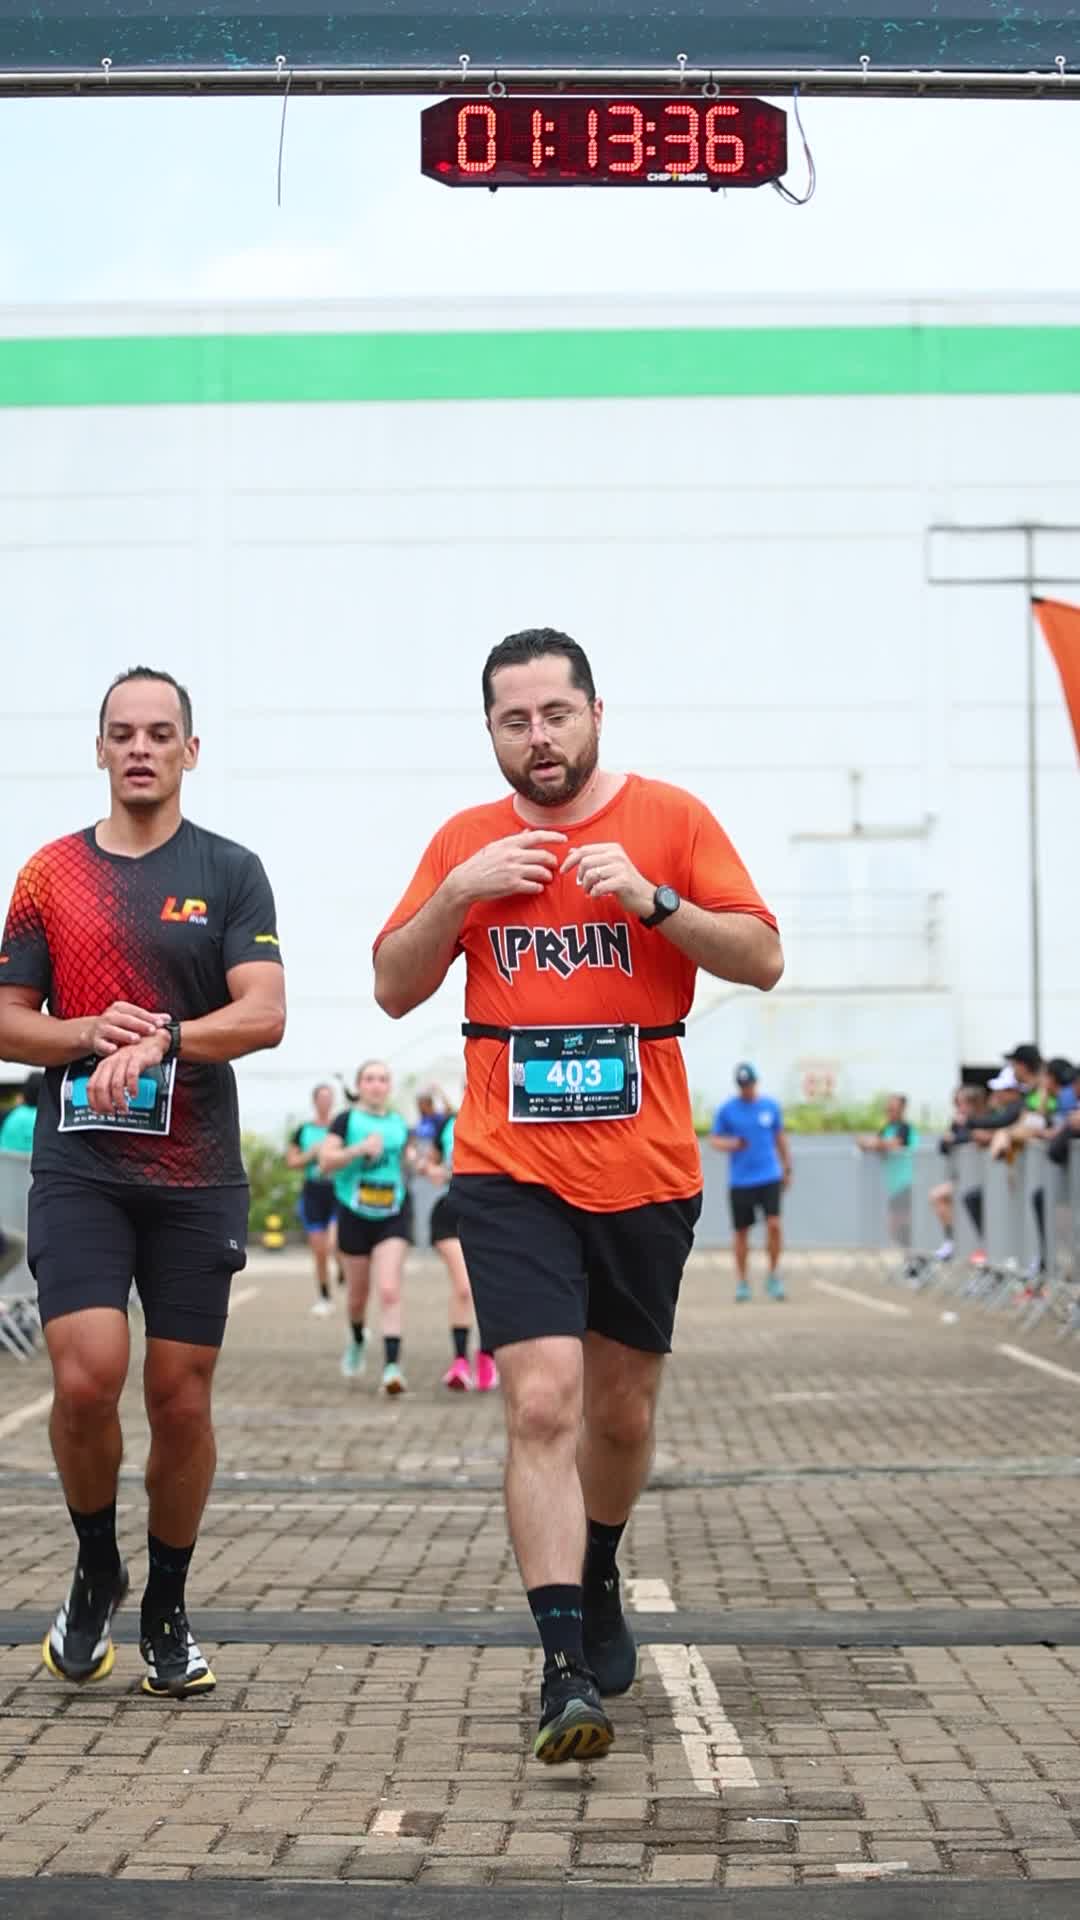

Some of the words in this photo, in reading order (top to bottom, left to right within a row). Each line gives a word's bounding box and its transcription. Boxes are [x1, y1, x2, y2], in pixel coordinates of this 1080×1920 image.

[457, 104, 745, 173] 01:13:36
[160, 896, 208, 922] LP
[188, 914, 208, 926] RUN
[546, 1059, 602, 1087] 403
